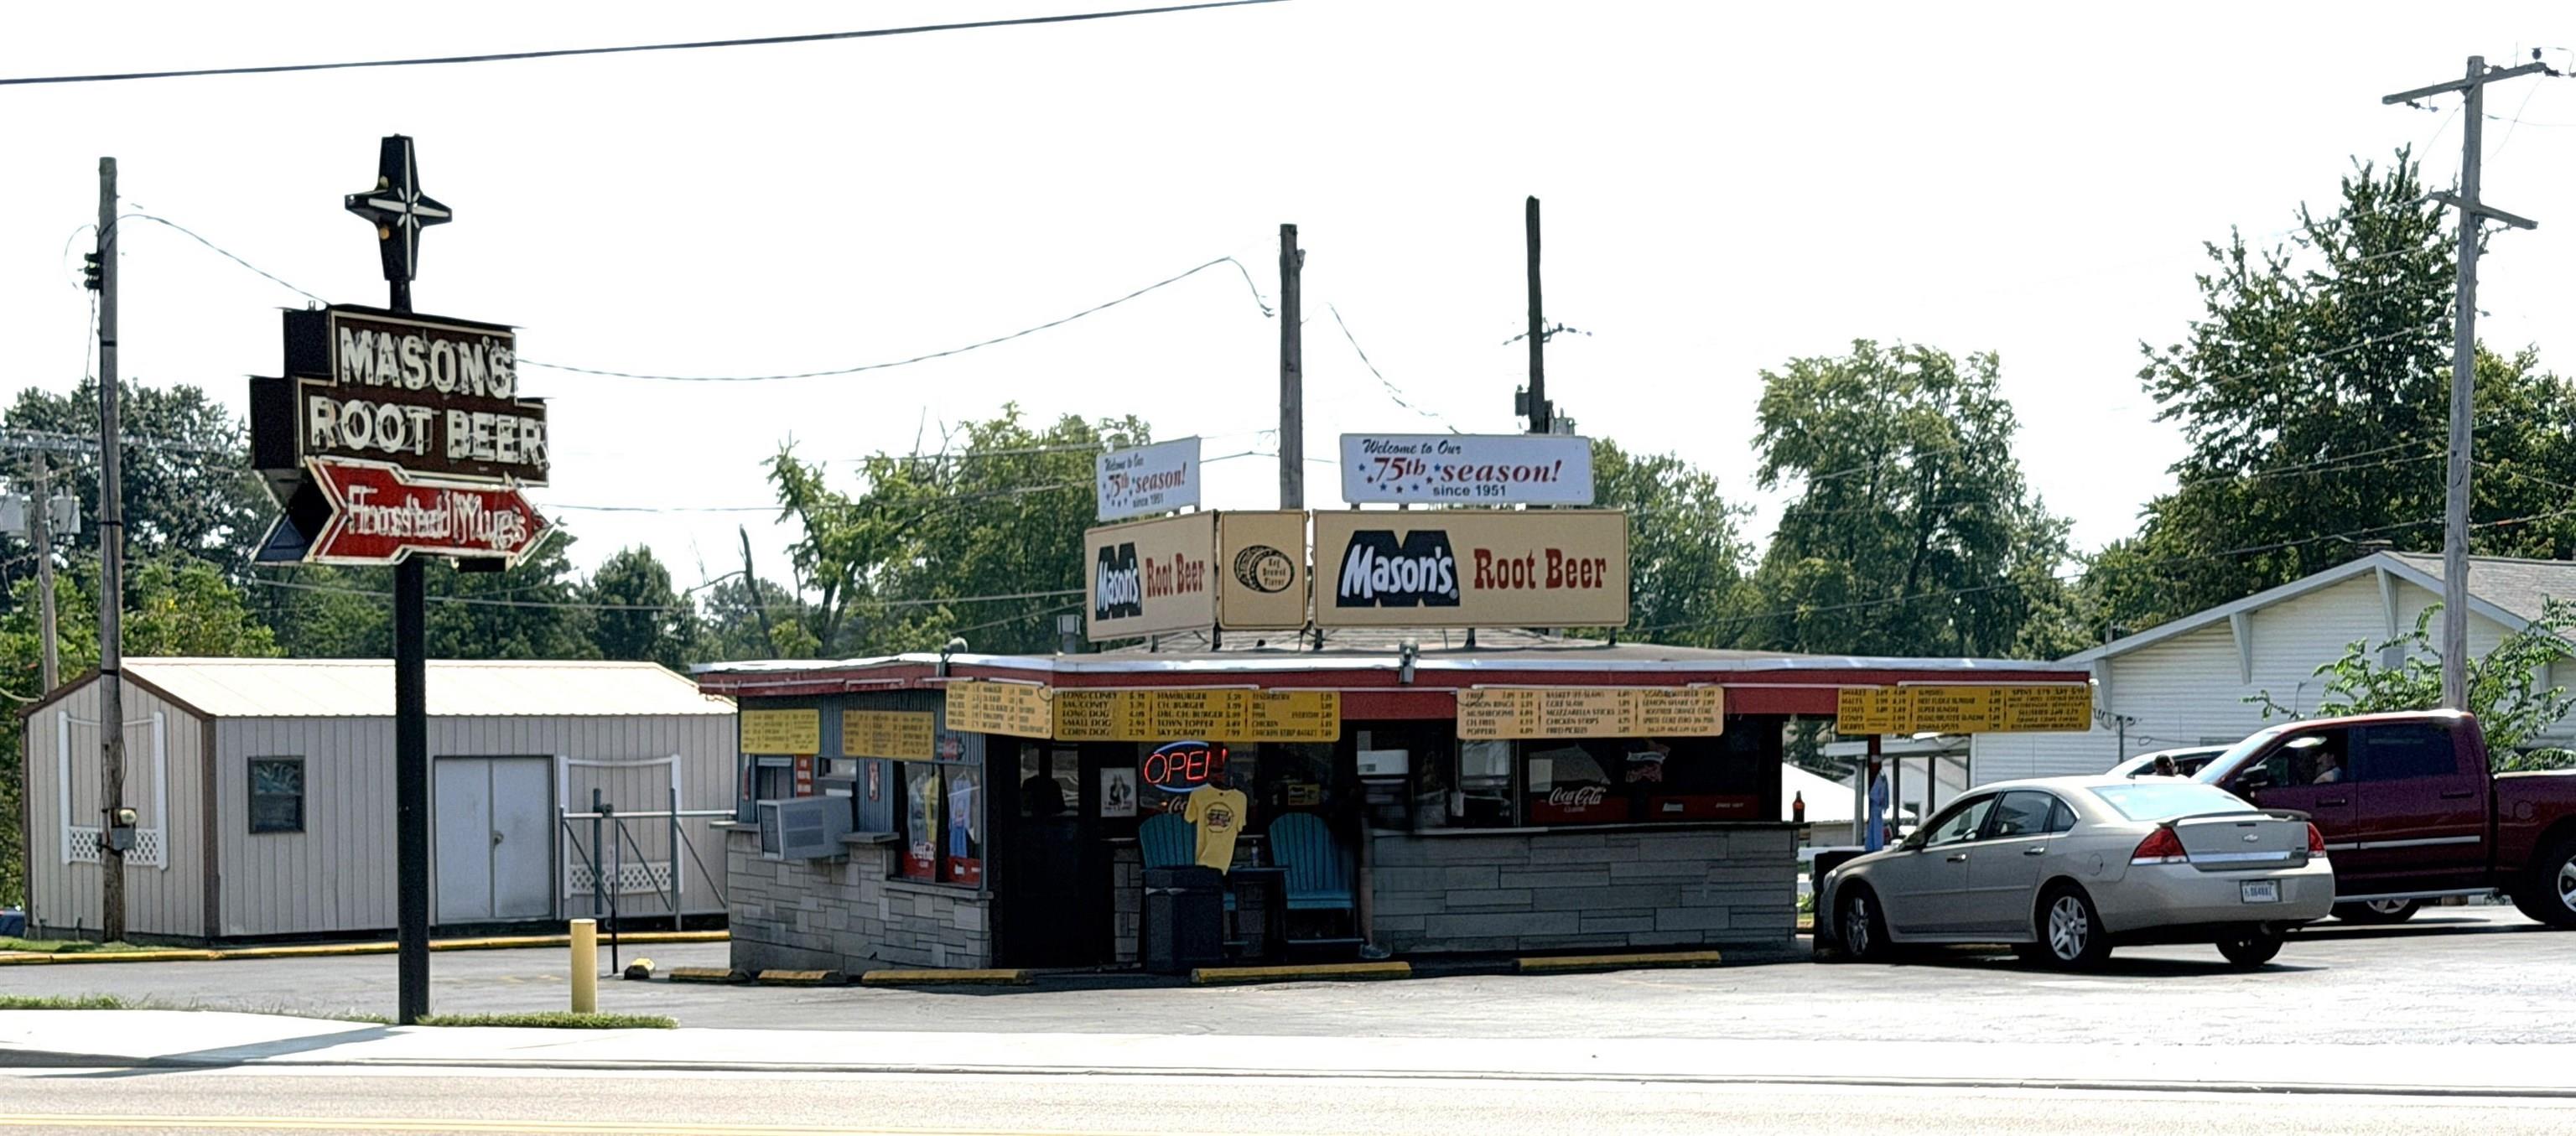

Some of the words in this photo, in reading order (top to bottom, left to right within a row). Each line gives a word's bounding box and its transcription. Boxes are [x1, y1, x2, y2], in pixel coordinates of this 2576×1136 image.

[340, 326, 516, 399] MASON'S
[309, 396, 434, 455] ROOT
[446, 408, 548, 466] BEER
[1362, 439, 1417, 454] Welcome
[1420, 441, 1432, 454] to
[1437, 440, 1462, 454] Our
[1135, 461, 1187, 494] season!
[1374, 458, 1426, 482] 75th
[1440, 459, 1562, 483] season!
[1432, 485, 1470, 496] since
[1476, 485, 1506, 496] 1951
[348, 485, 451, 539] Frosted
[453, 490, 527, 551] Mugs
[1097, 558, 1139, 612] Mason's
[1146, 557, 1173, 598] Root
[1176, 552, 1205, 594] Beer
[1342, 543, 1453, 599] Mason's
[1473, 548, 1536, 589] Root
[1545, 548, 1607, 589] Beer
[1549, 786, 1607, 807] Coca-Cola
